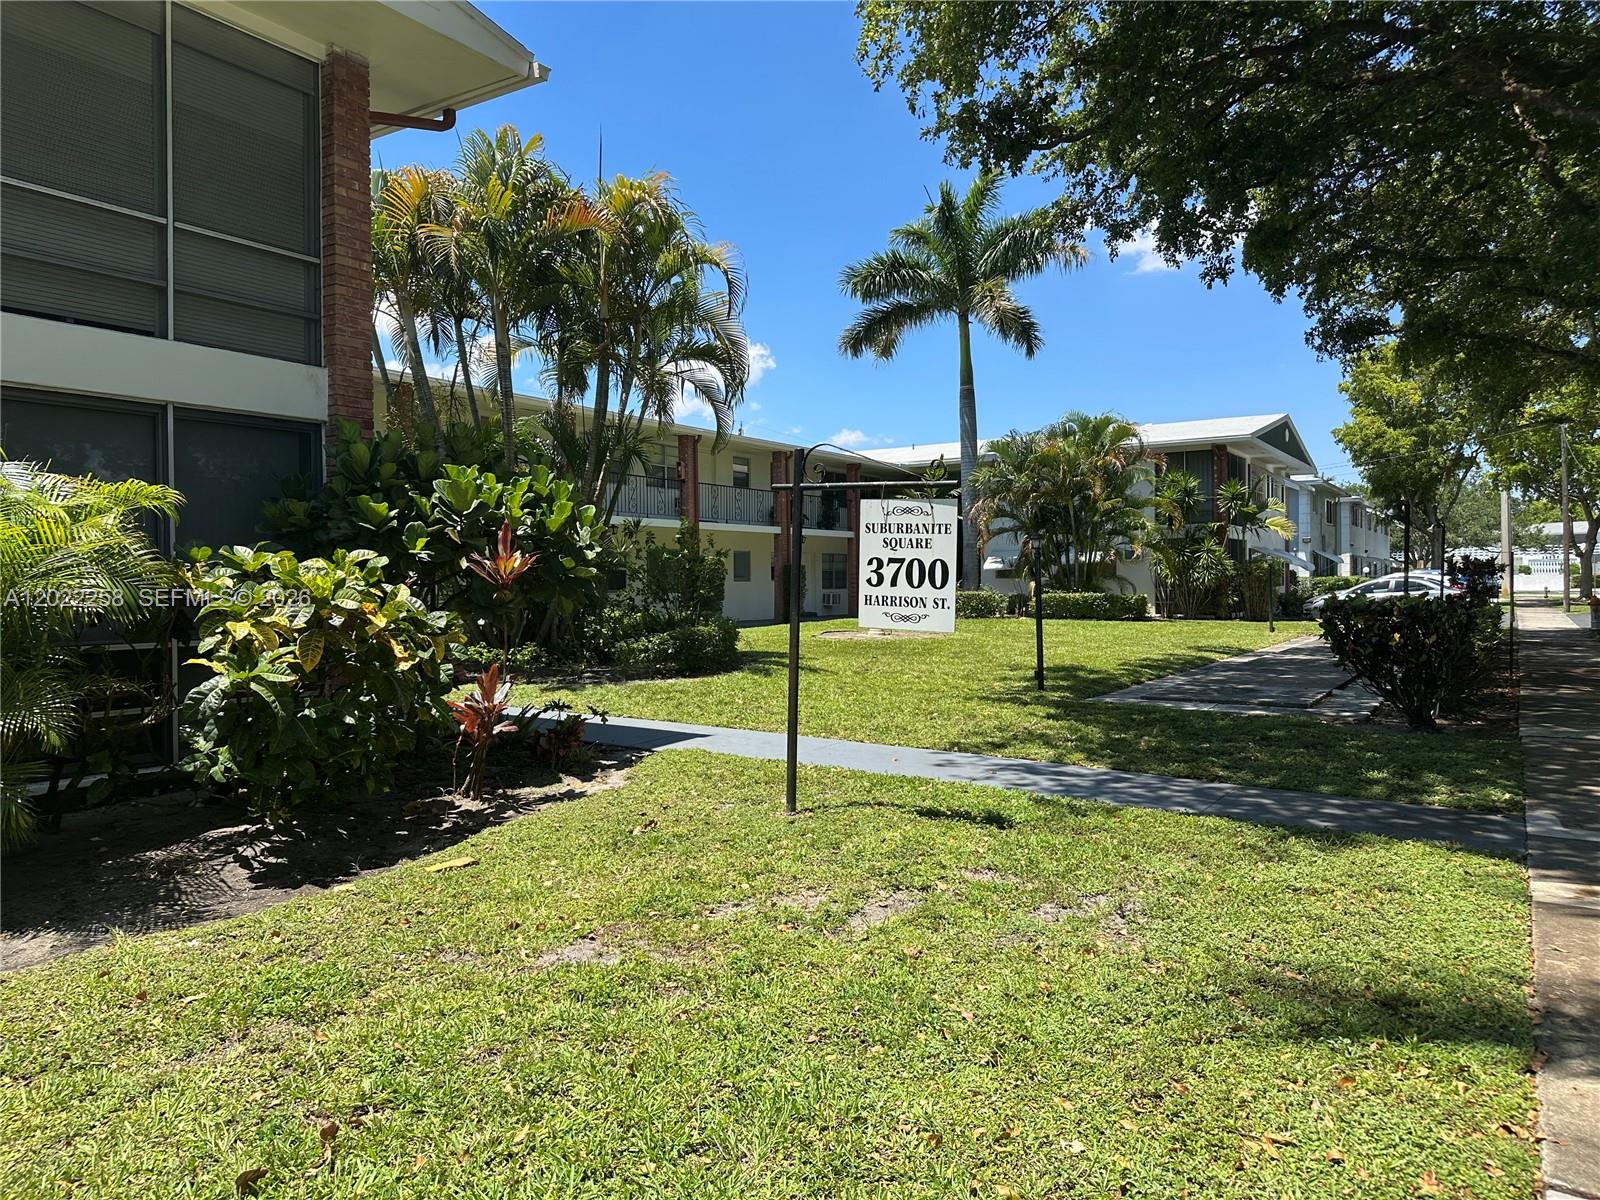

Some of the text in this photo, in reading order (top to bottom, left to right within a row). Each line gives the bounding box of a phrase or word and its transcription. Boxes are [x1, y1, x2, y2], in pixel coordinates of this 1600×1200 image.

[864, 522, 952, 535] SUBURBANITE
[882, 537, 932, 551] SQUARE
[865, 556, 950, 590] 3700
[864, 594, 950, 610] HARRISON ST.
